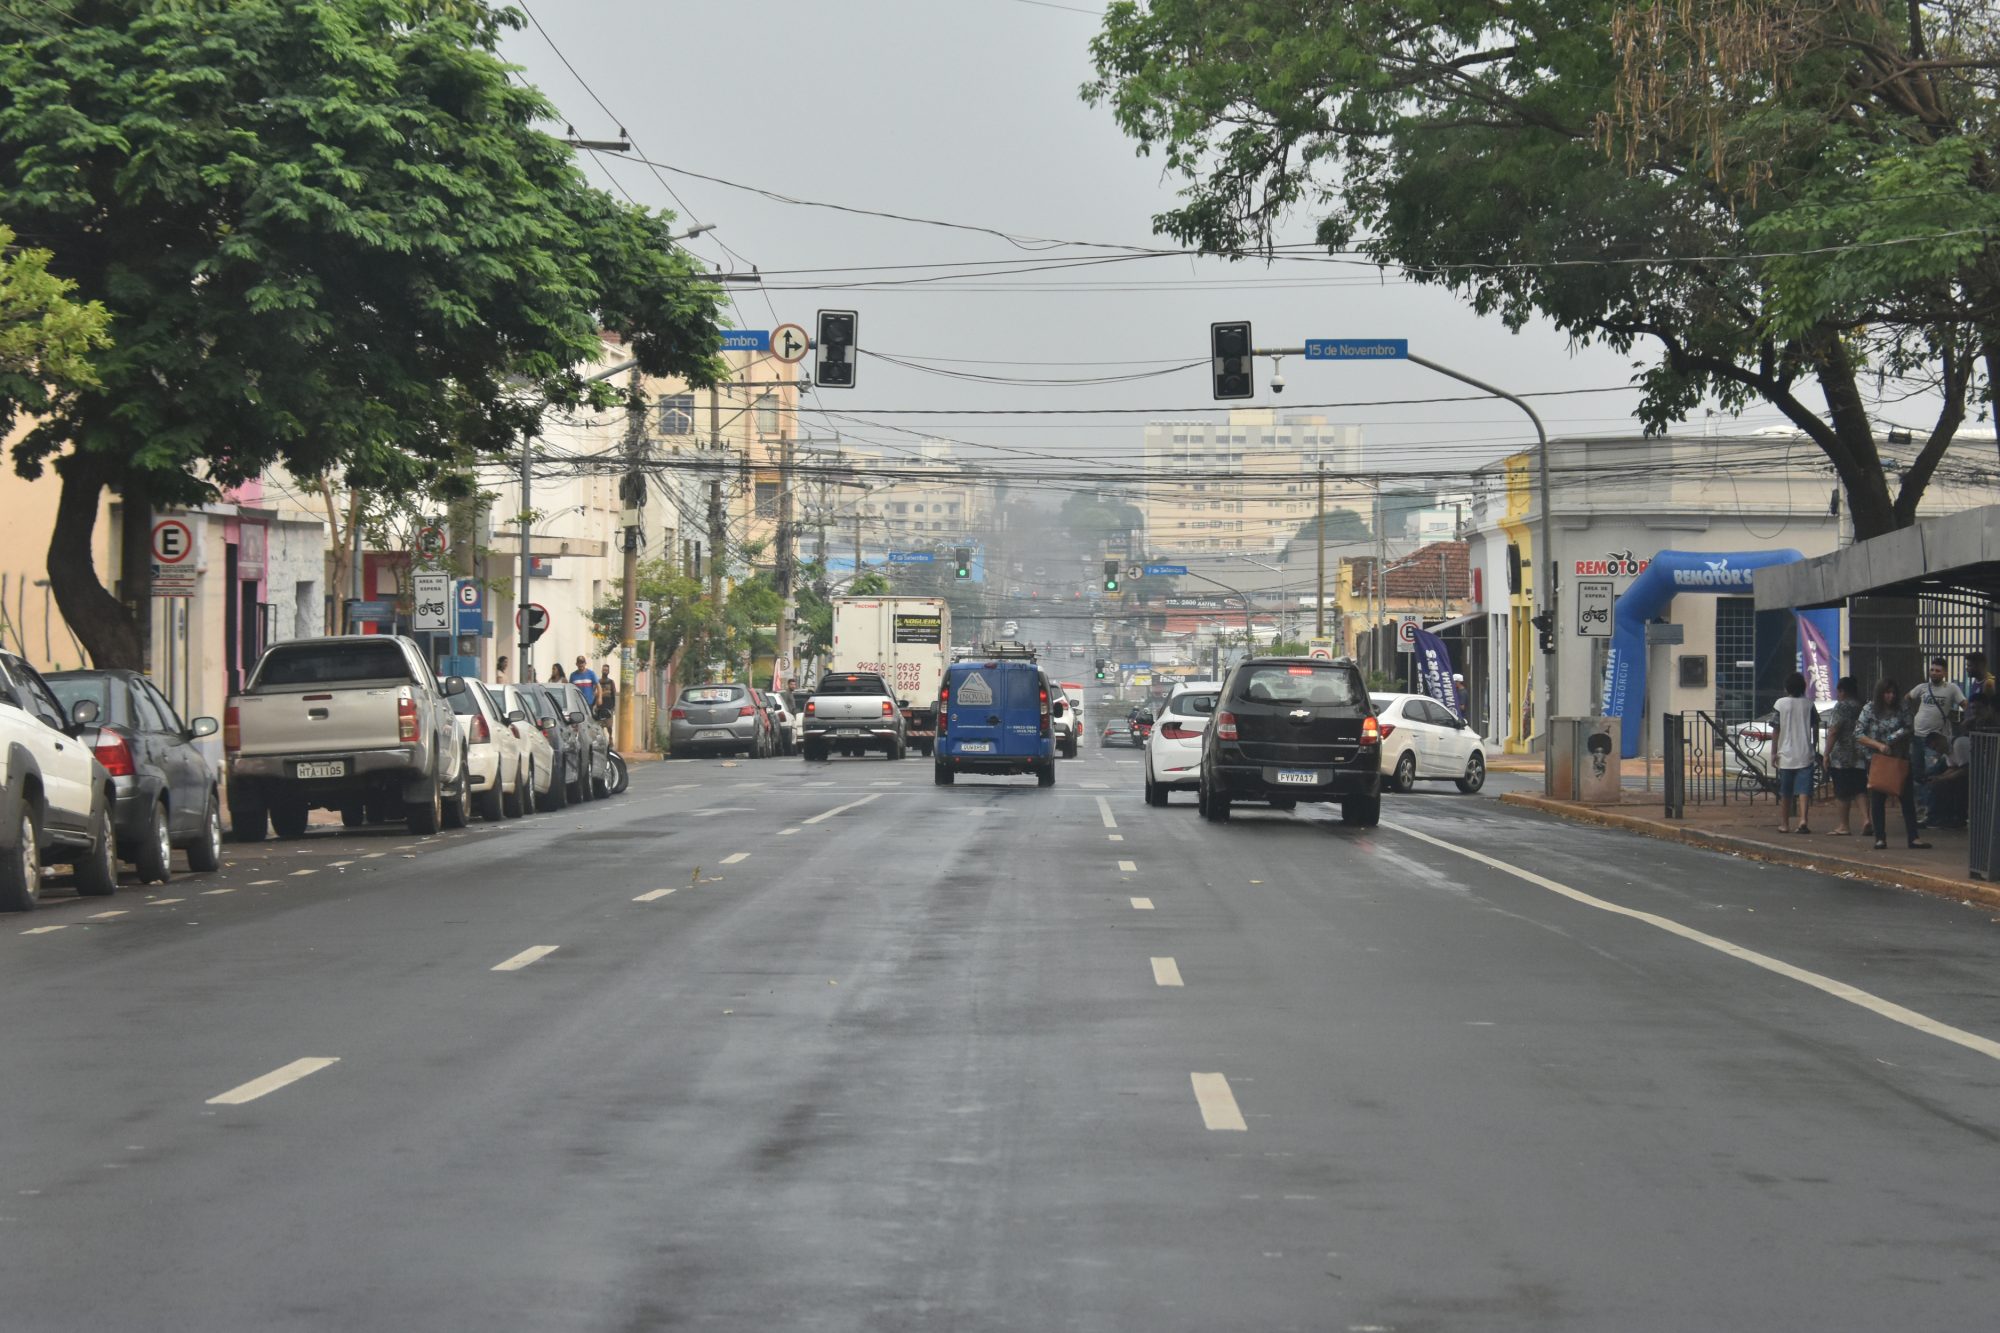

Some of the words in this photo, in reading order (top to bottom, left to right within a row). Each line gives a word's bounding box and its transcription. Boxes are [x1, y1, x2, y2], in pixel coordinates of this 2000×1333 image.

[723, 336, 759, 347] embro
[1308, 344, 1321, 356] 15
[1324, 344, 1337, 356] de
[1340, 344, 1396, 356] Novembro
[162, 529, 179, 555] E
[1575, 558, 1652, 575] REMOTOR'
[1673, 568, 1753, 586] REMOTOR'S
[464, 589, 473, 601] E
[1425, 649, 1444, 702] OTOR'S
[1600, 648, 1617, 710] YAMAHA
[1441, 671, 1456, 708] YAMAHA
[1280, 773, 1314, 783] FYV7A17
